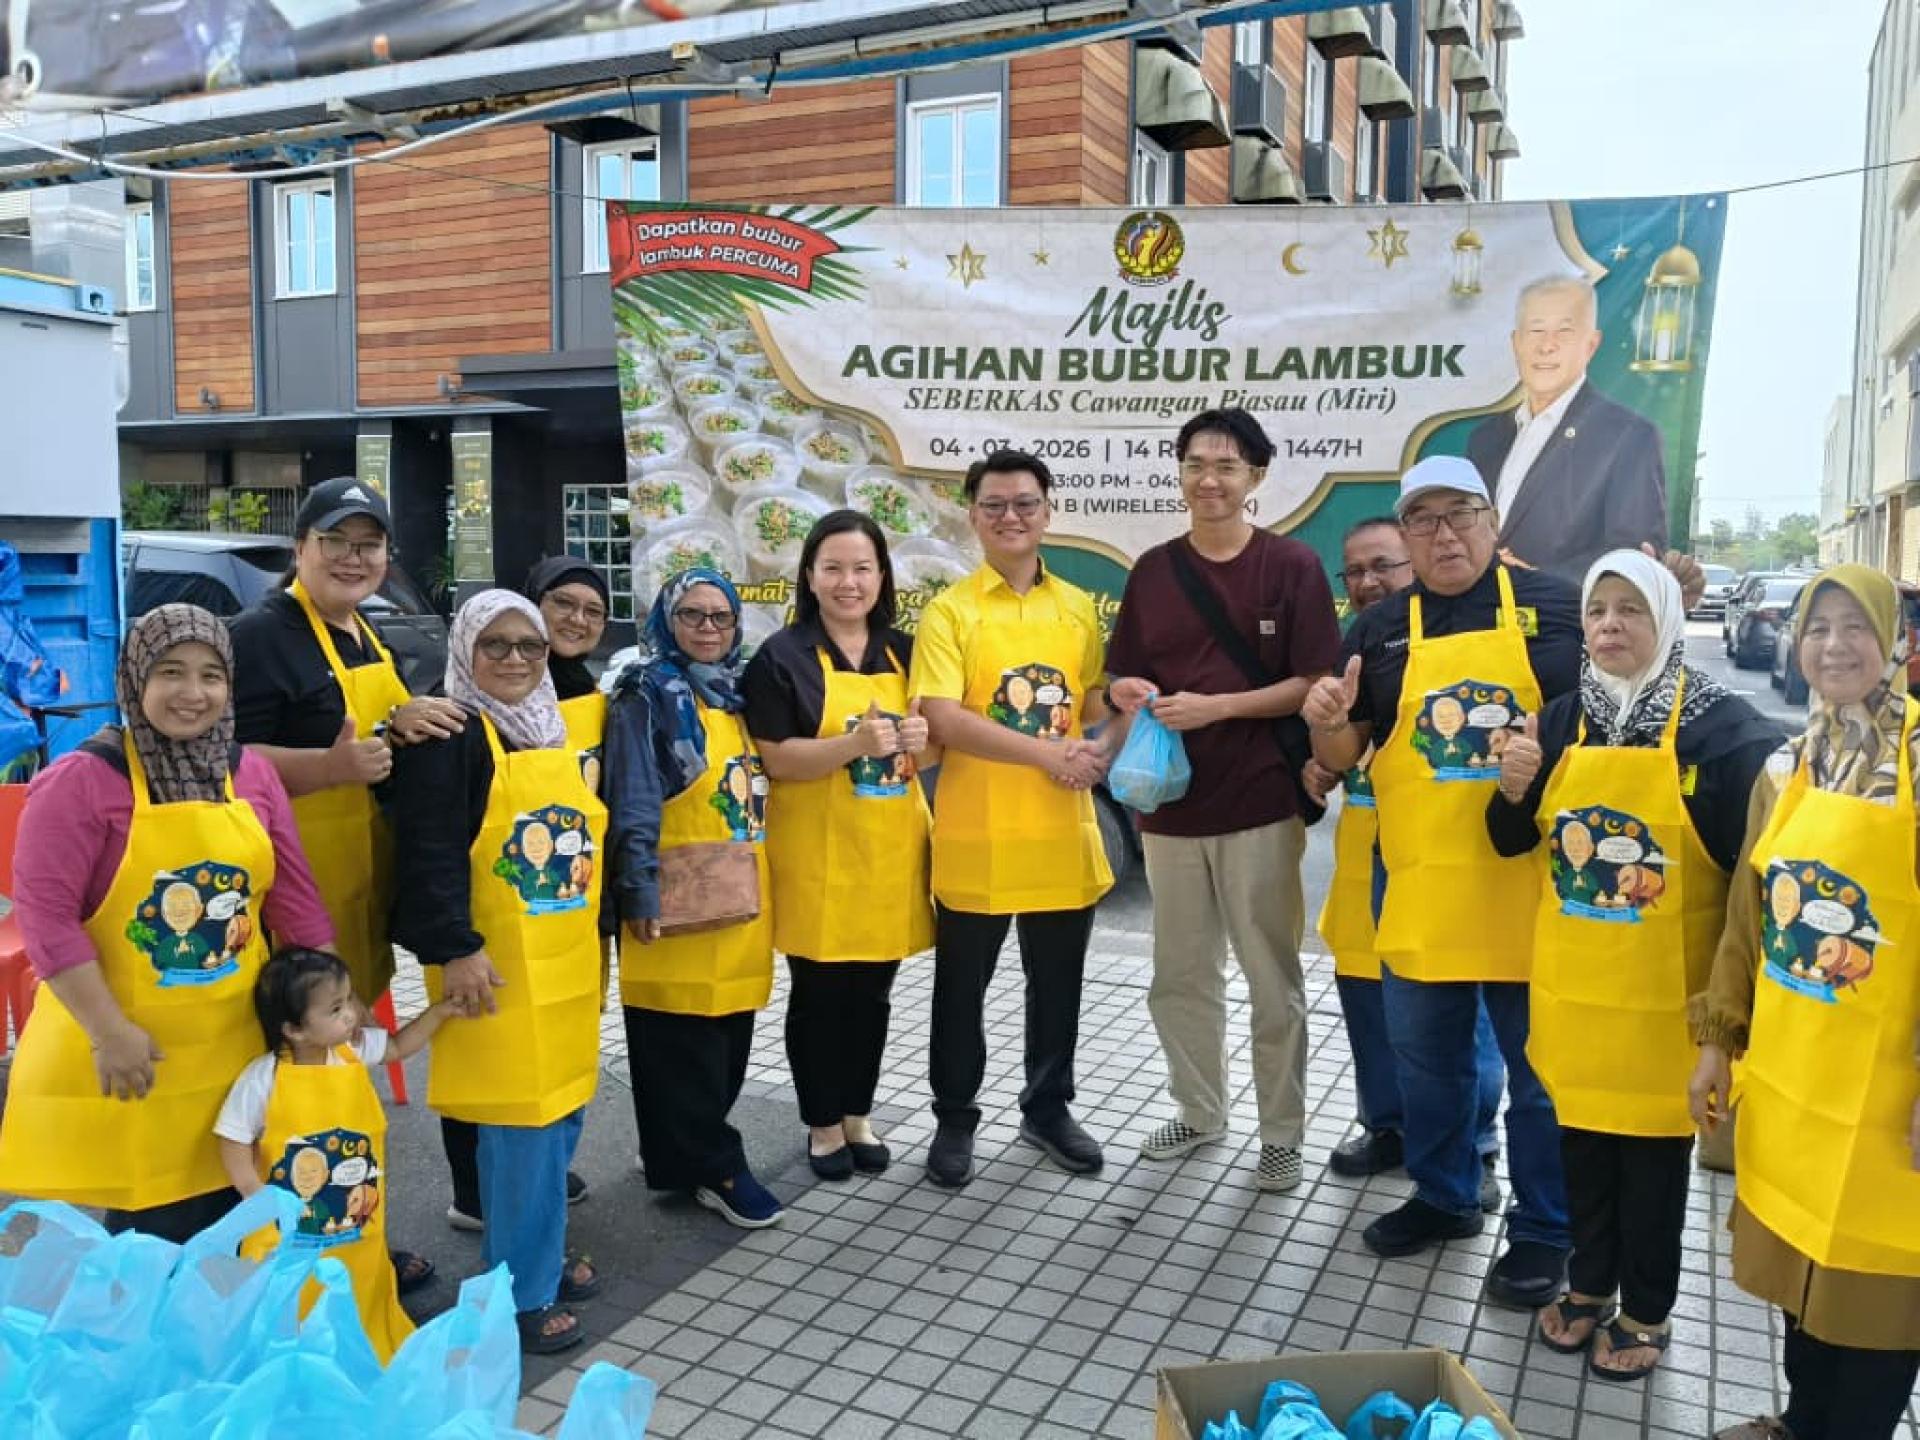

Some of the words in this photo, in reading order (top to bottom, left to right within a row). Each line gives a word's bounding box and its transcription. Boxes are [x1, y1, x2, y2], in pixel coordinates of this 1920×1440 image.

[637, 217, 736, 241] Dapatkan
[741, 220, 804, 252] bubur
[639, 244, 704, 266] lambuk
[709, 245, 799, 279] PERCUMA
[1064, 278, 1233, 348] Majlis
[841, 344, 1044, 382] AGIHAN
[1058, 347, 1231, 382] BUBUR
[1244, 344, 1466, 381] LAMBUK
[903, 387, 1064, 412] SEBERKAS
[1070, 389, 1209, 419] Cawangan
[1218, 388, 1308, 412] Piasau
[1317, 386, 1396, 417] (Miri)
[929, 438, 961, 457] 04
[1032, 439, 1090, 458] 2026
[1124, 439, 1149, 458] 14
[1284, 438, 1363, 458] 1447H
[1100, 473, 1130, 489] PM
[1064, 498, 1077, 513] B
[1083, 497, 1188, 517] (WIRELESS
